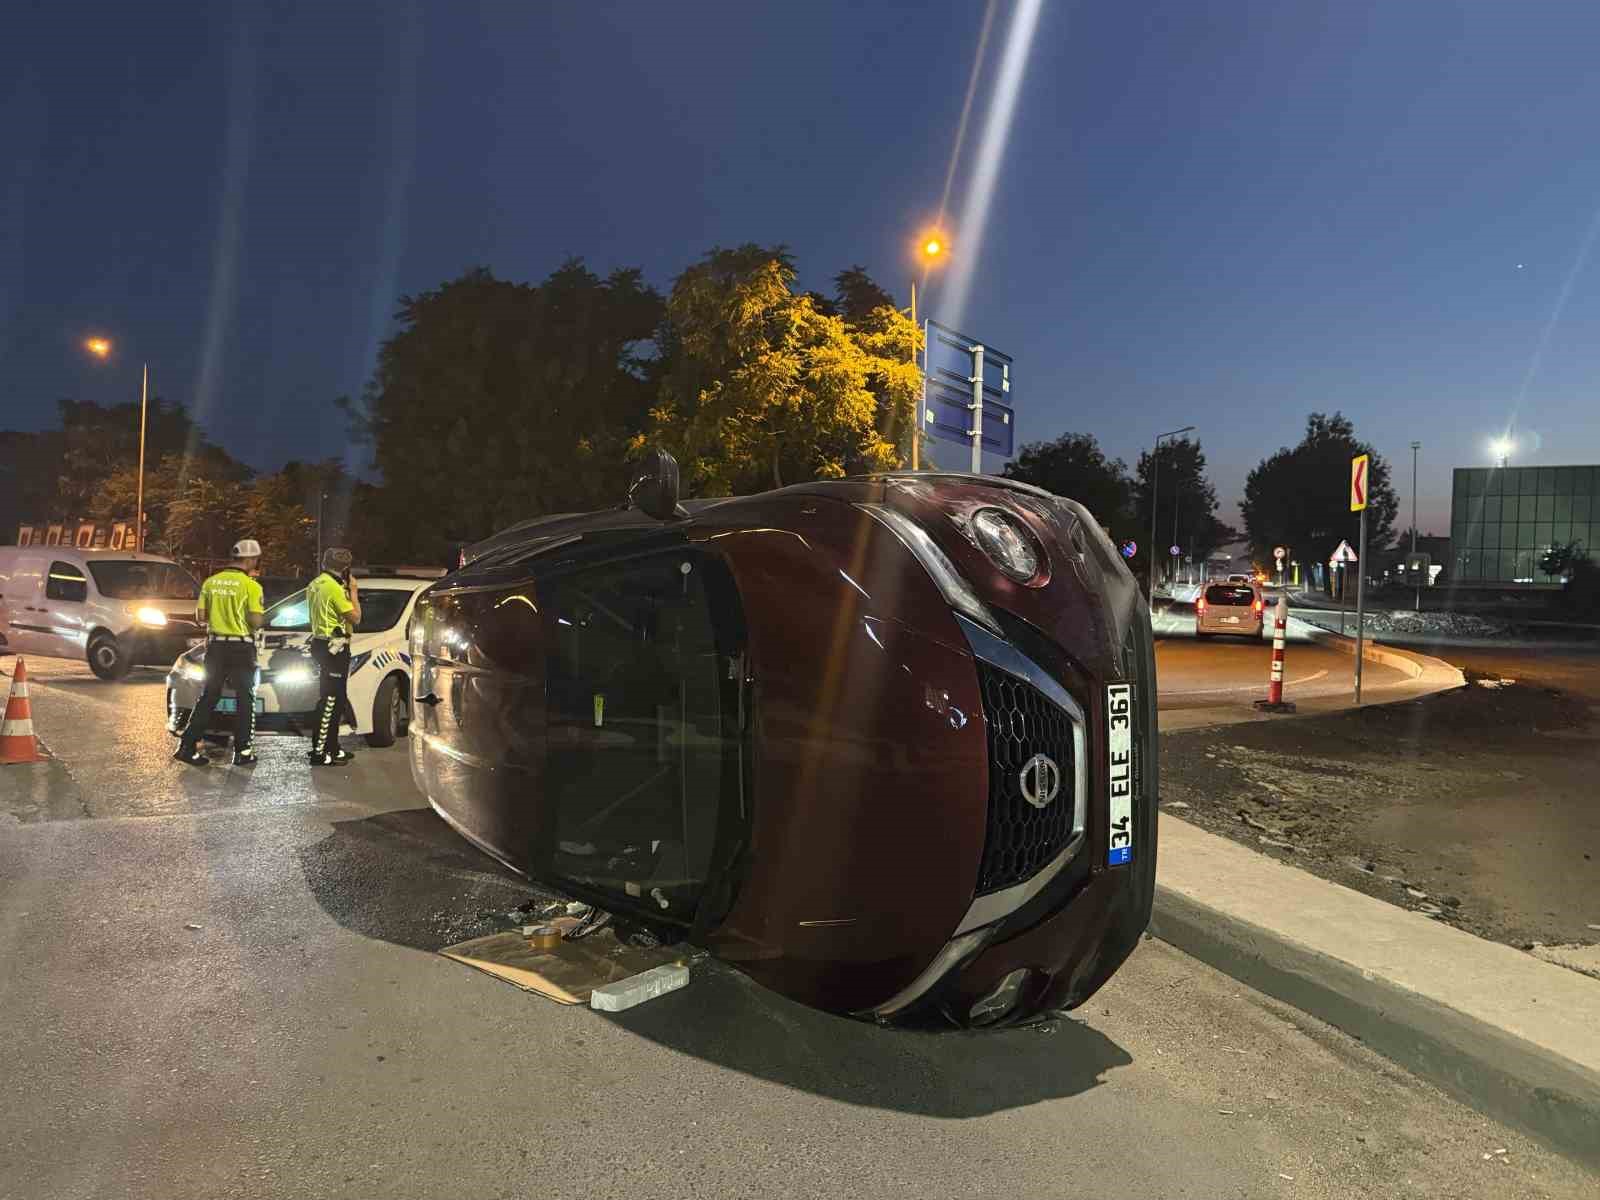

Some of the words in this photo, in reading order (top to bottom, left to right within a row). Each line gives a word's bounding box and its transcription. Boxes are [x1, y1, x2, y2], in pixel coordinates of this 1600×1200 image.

[1110, 687, 1129, 730] 361
[1111, 750, 1130, 798] ELE
[1111, 815, 1130, 848] 34
